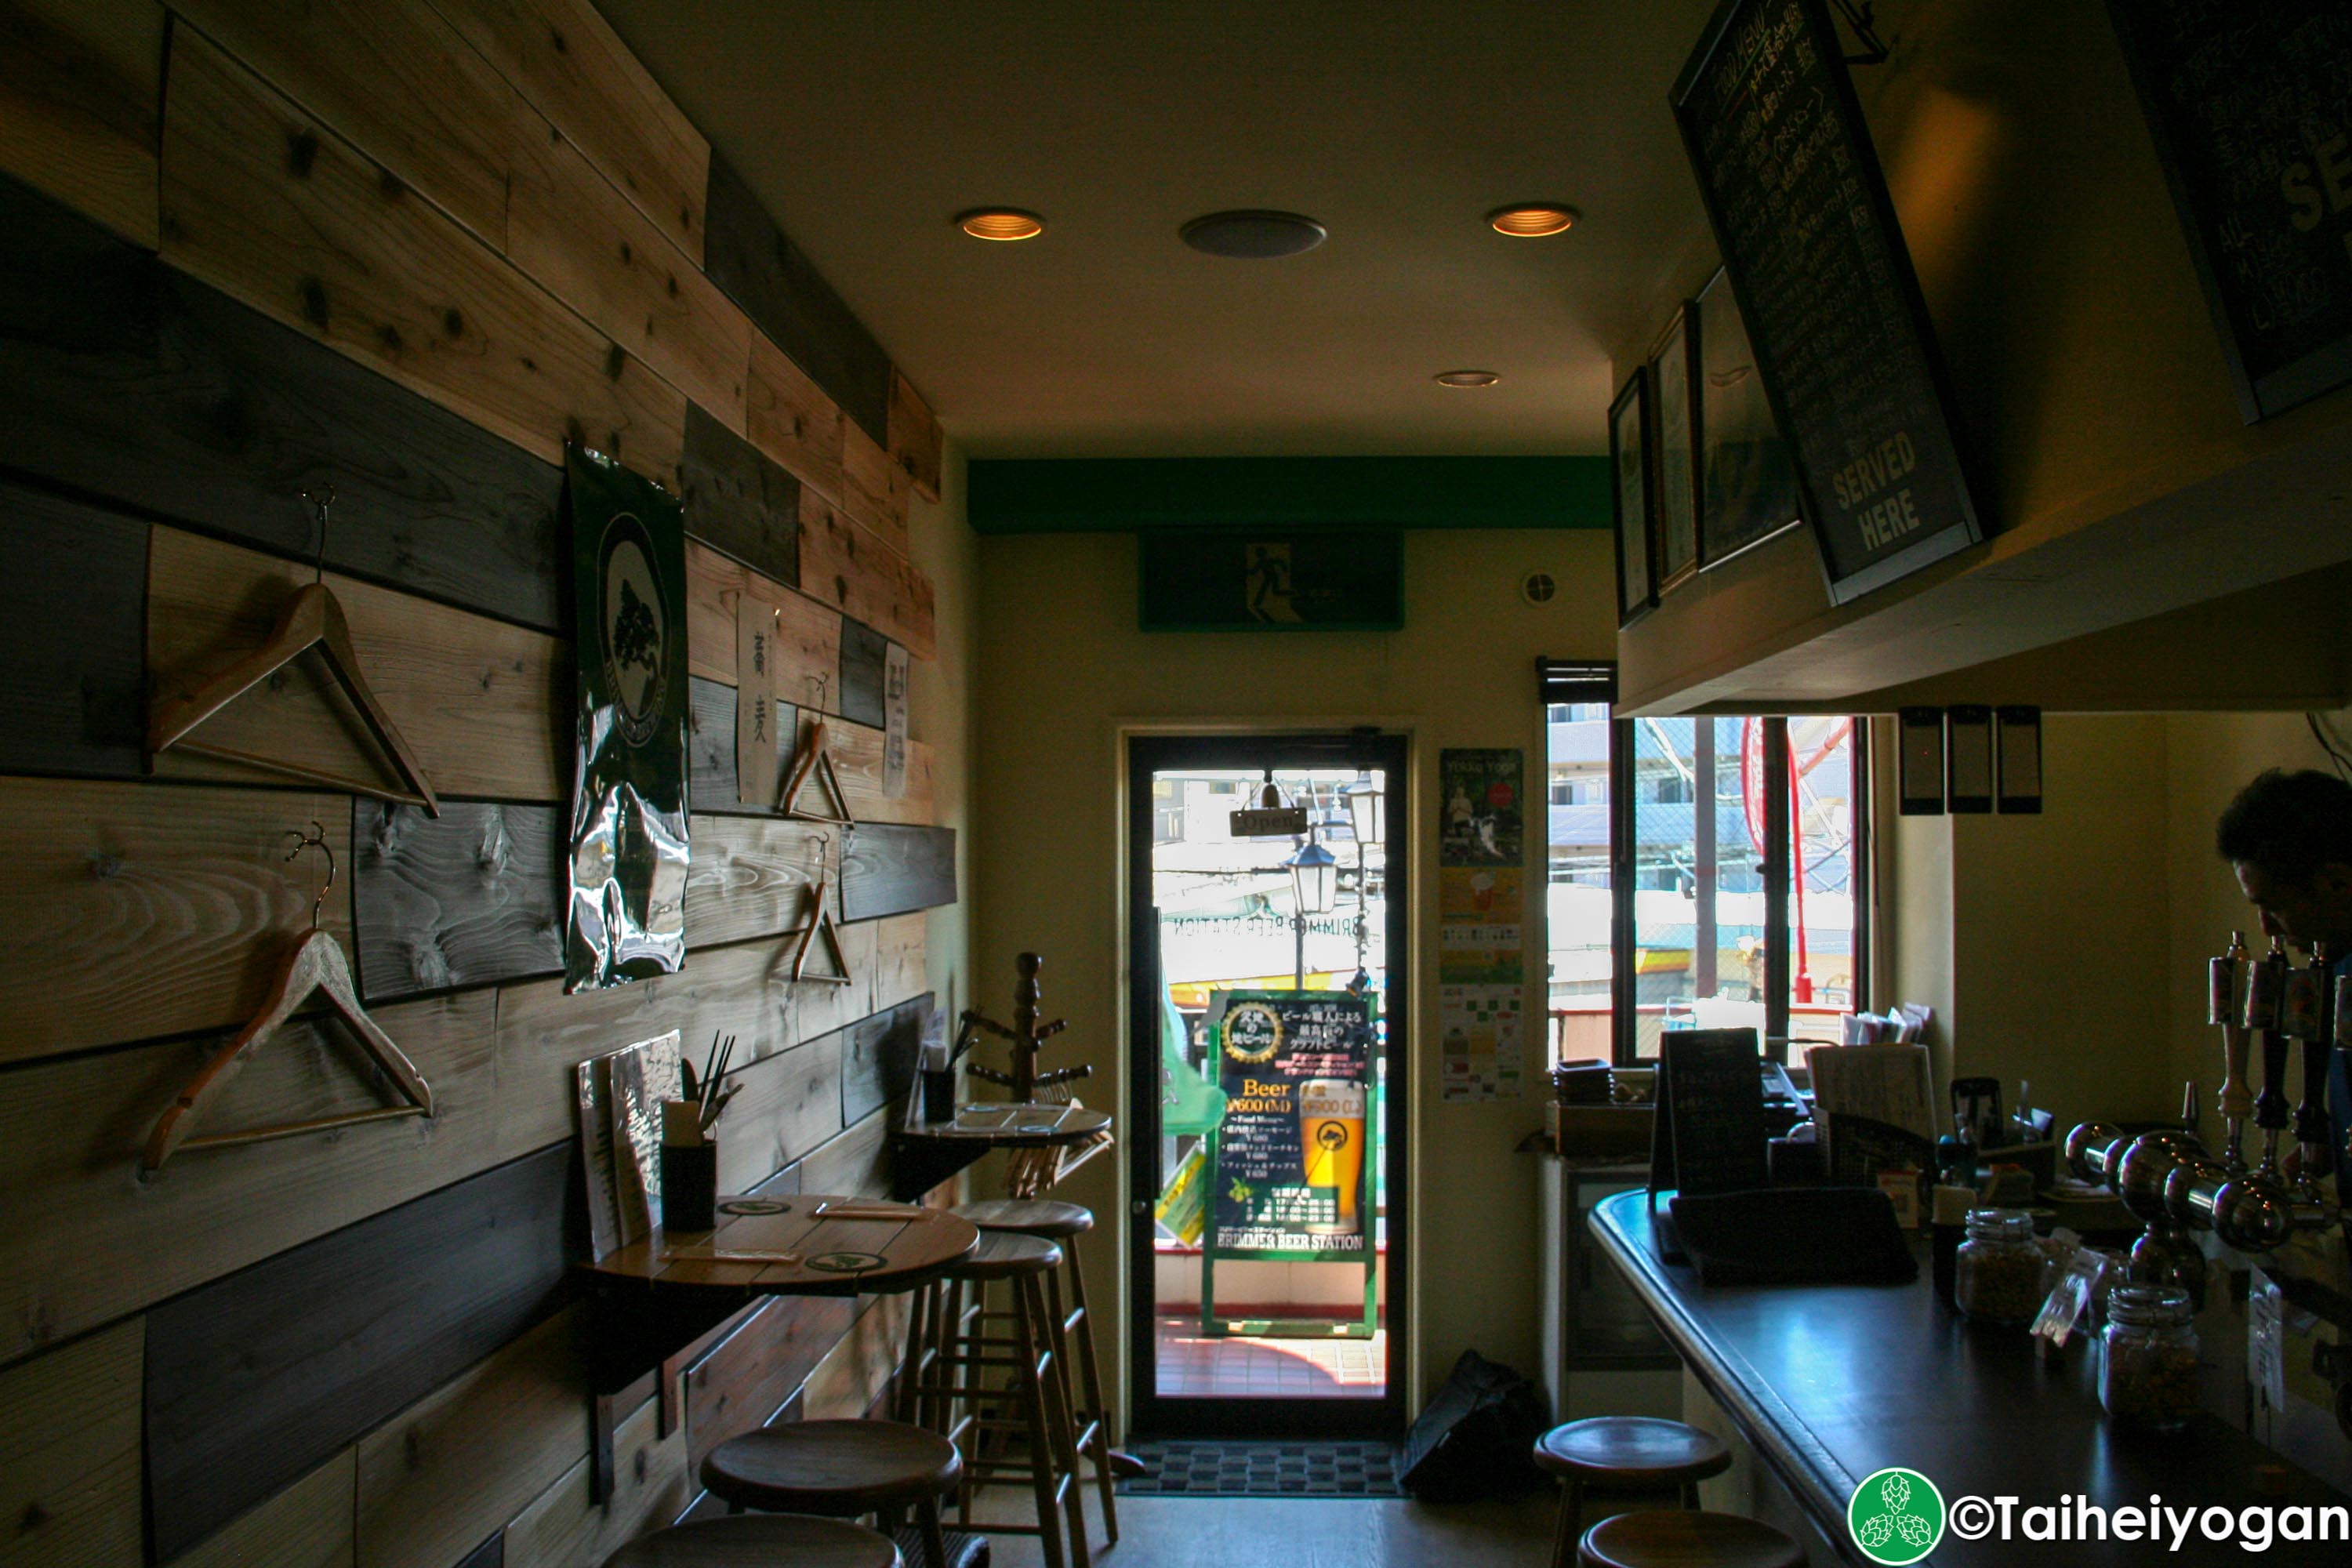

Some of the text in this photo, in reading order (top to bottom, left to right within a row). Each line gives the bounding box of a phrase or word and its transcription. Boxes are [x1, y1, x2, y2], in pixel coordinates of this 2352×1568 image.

[1832, 430, 1915, 510] SERVED
[1857, 488, 1921, 552] HERE
[1243, 1078, 1292, 1097] Beer
[1218, 1233, 1363, 1250] BRIMMER BEER STATION
